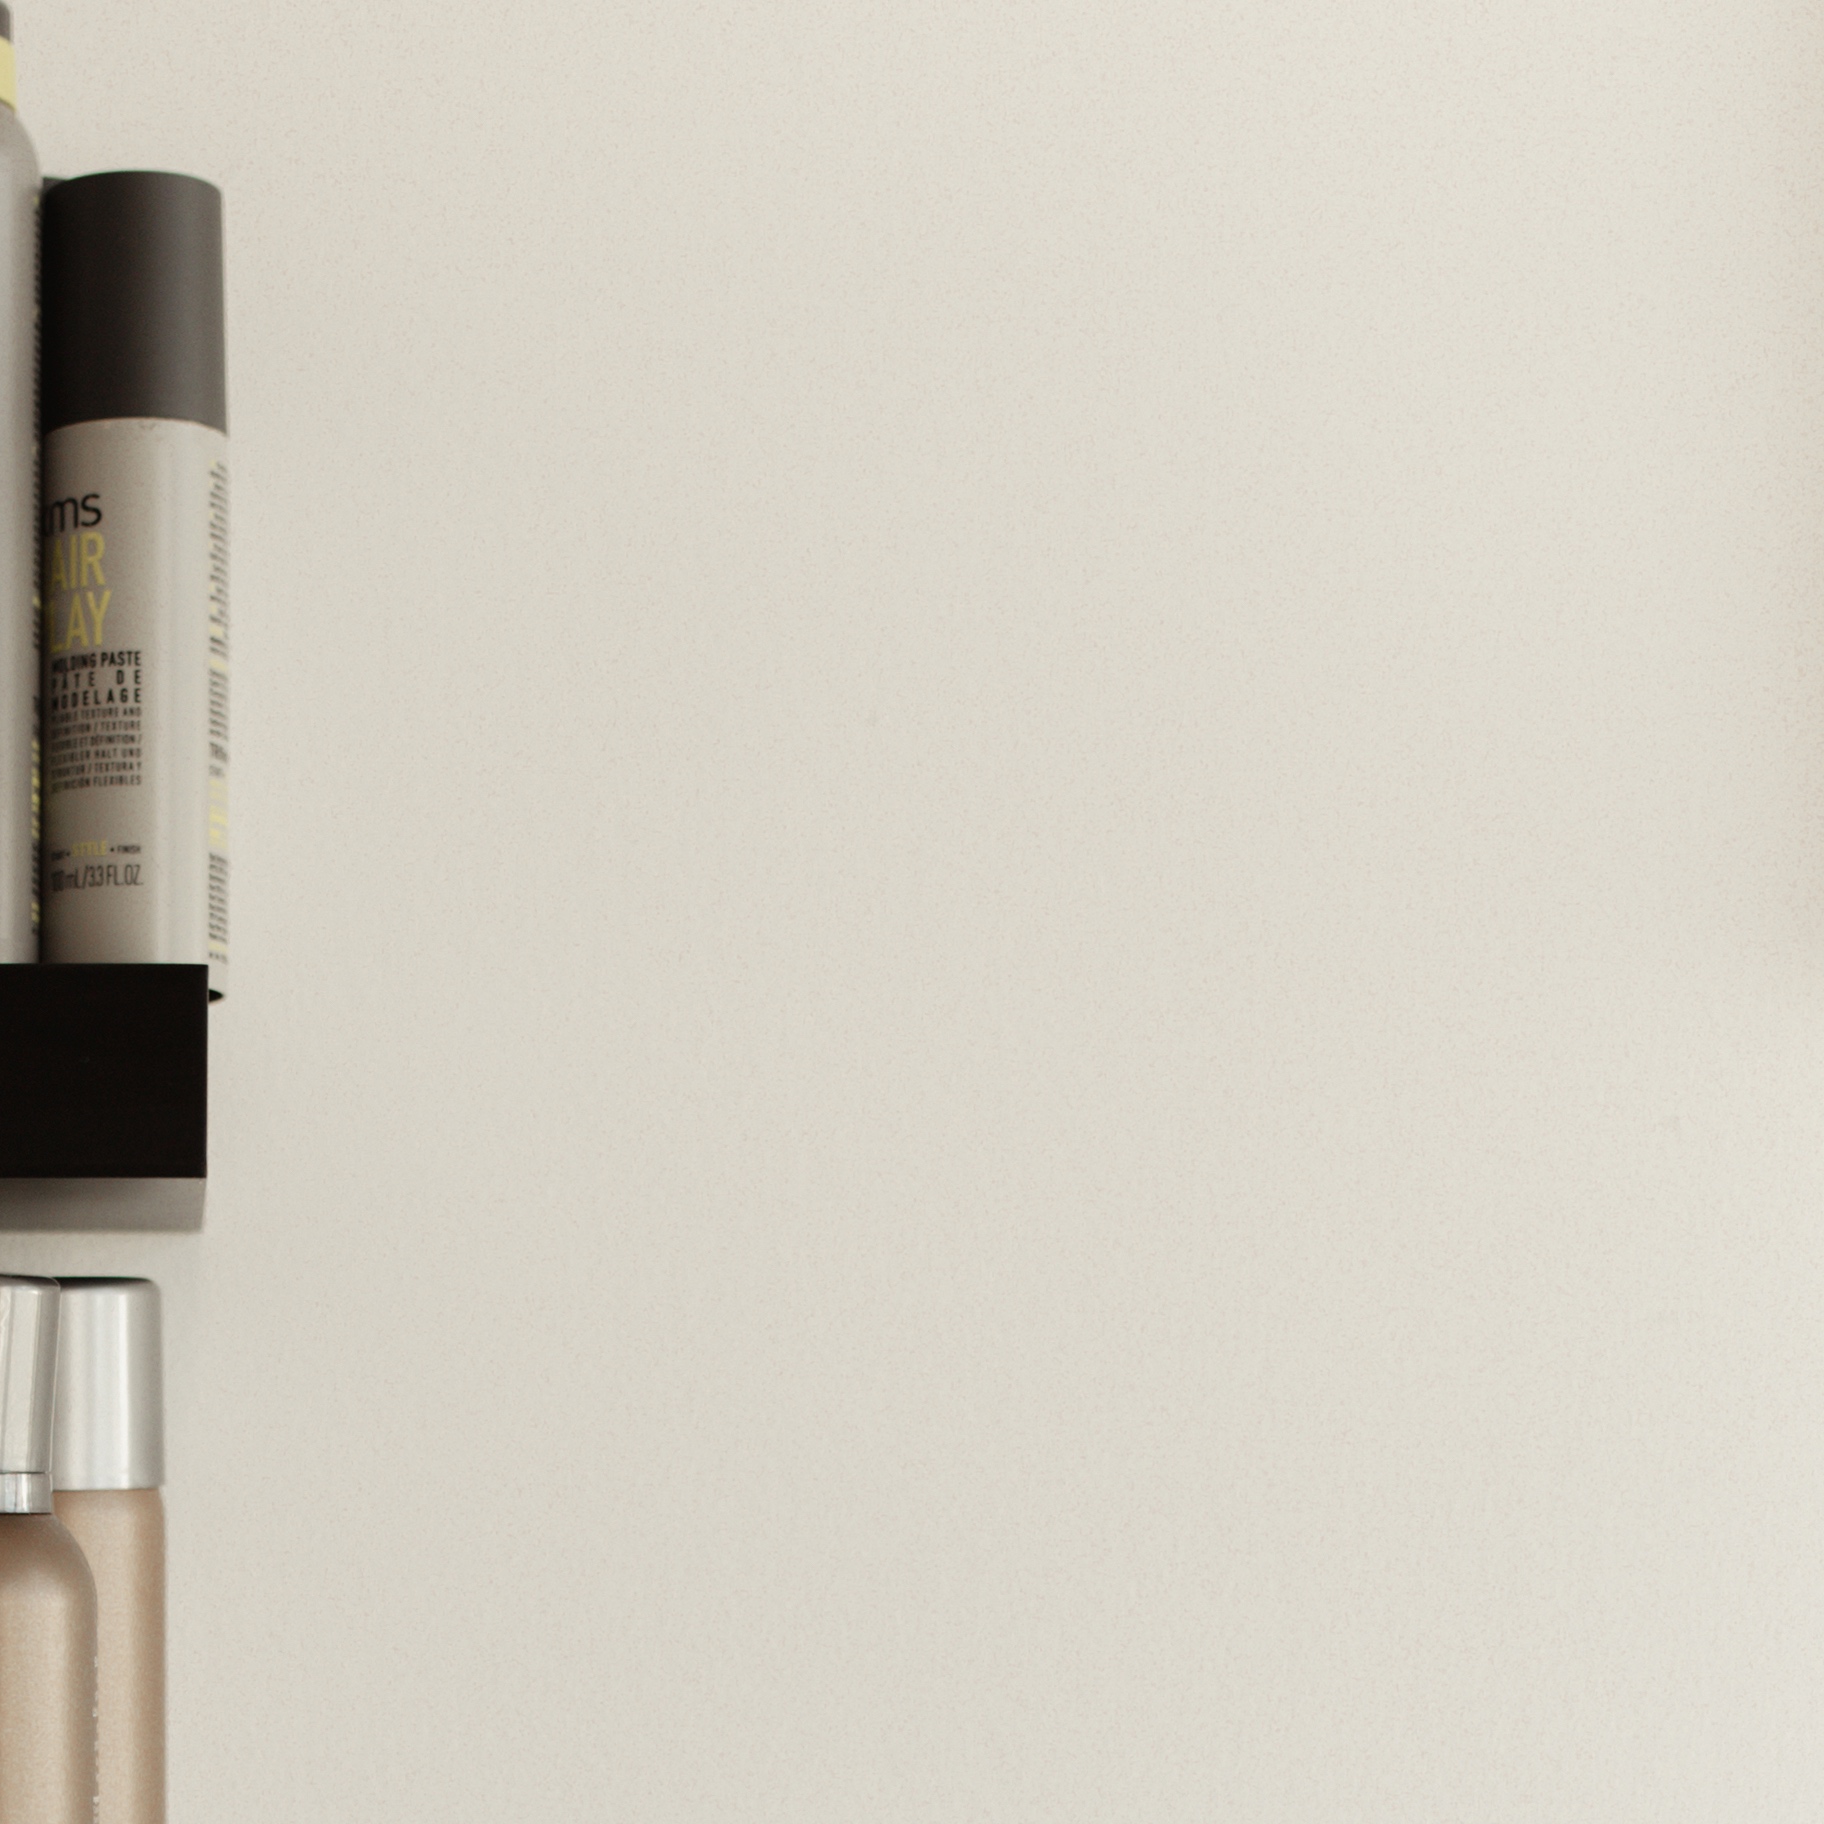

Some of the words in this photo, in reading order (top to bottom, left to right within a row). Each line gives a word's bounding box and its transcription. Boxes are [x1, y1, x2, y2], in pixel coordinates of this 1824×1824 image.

[45, 531, 106, 592] AIR
[45, 589, 112, 655] LAY
[100, 650, 141, 668] PASTE
[116, 669, 141, 686] DE
[52, 688, 141, 711] MODELAGE
